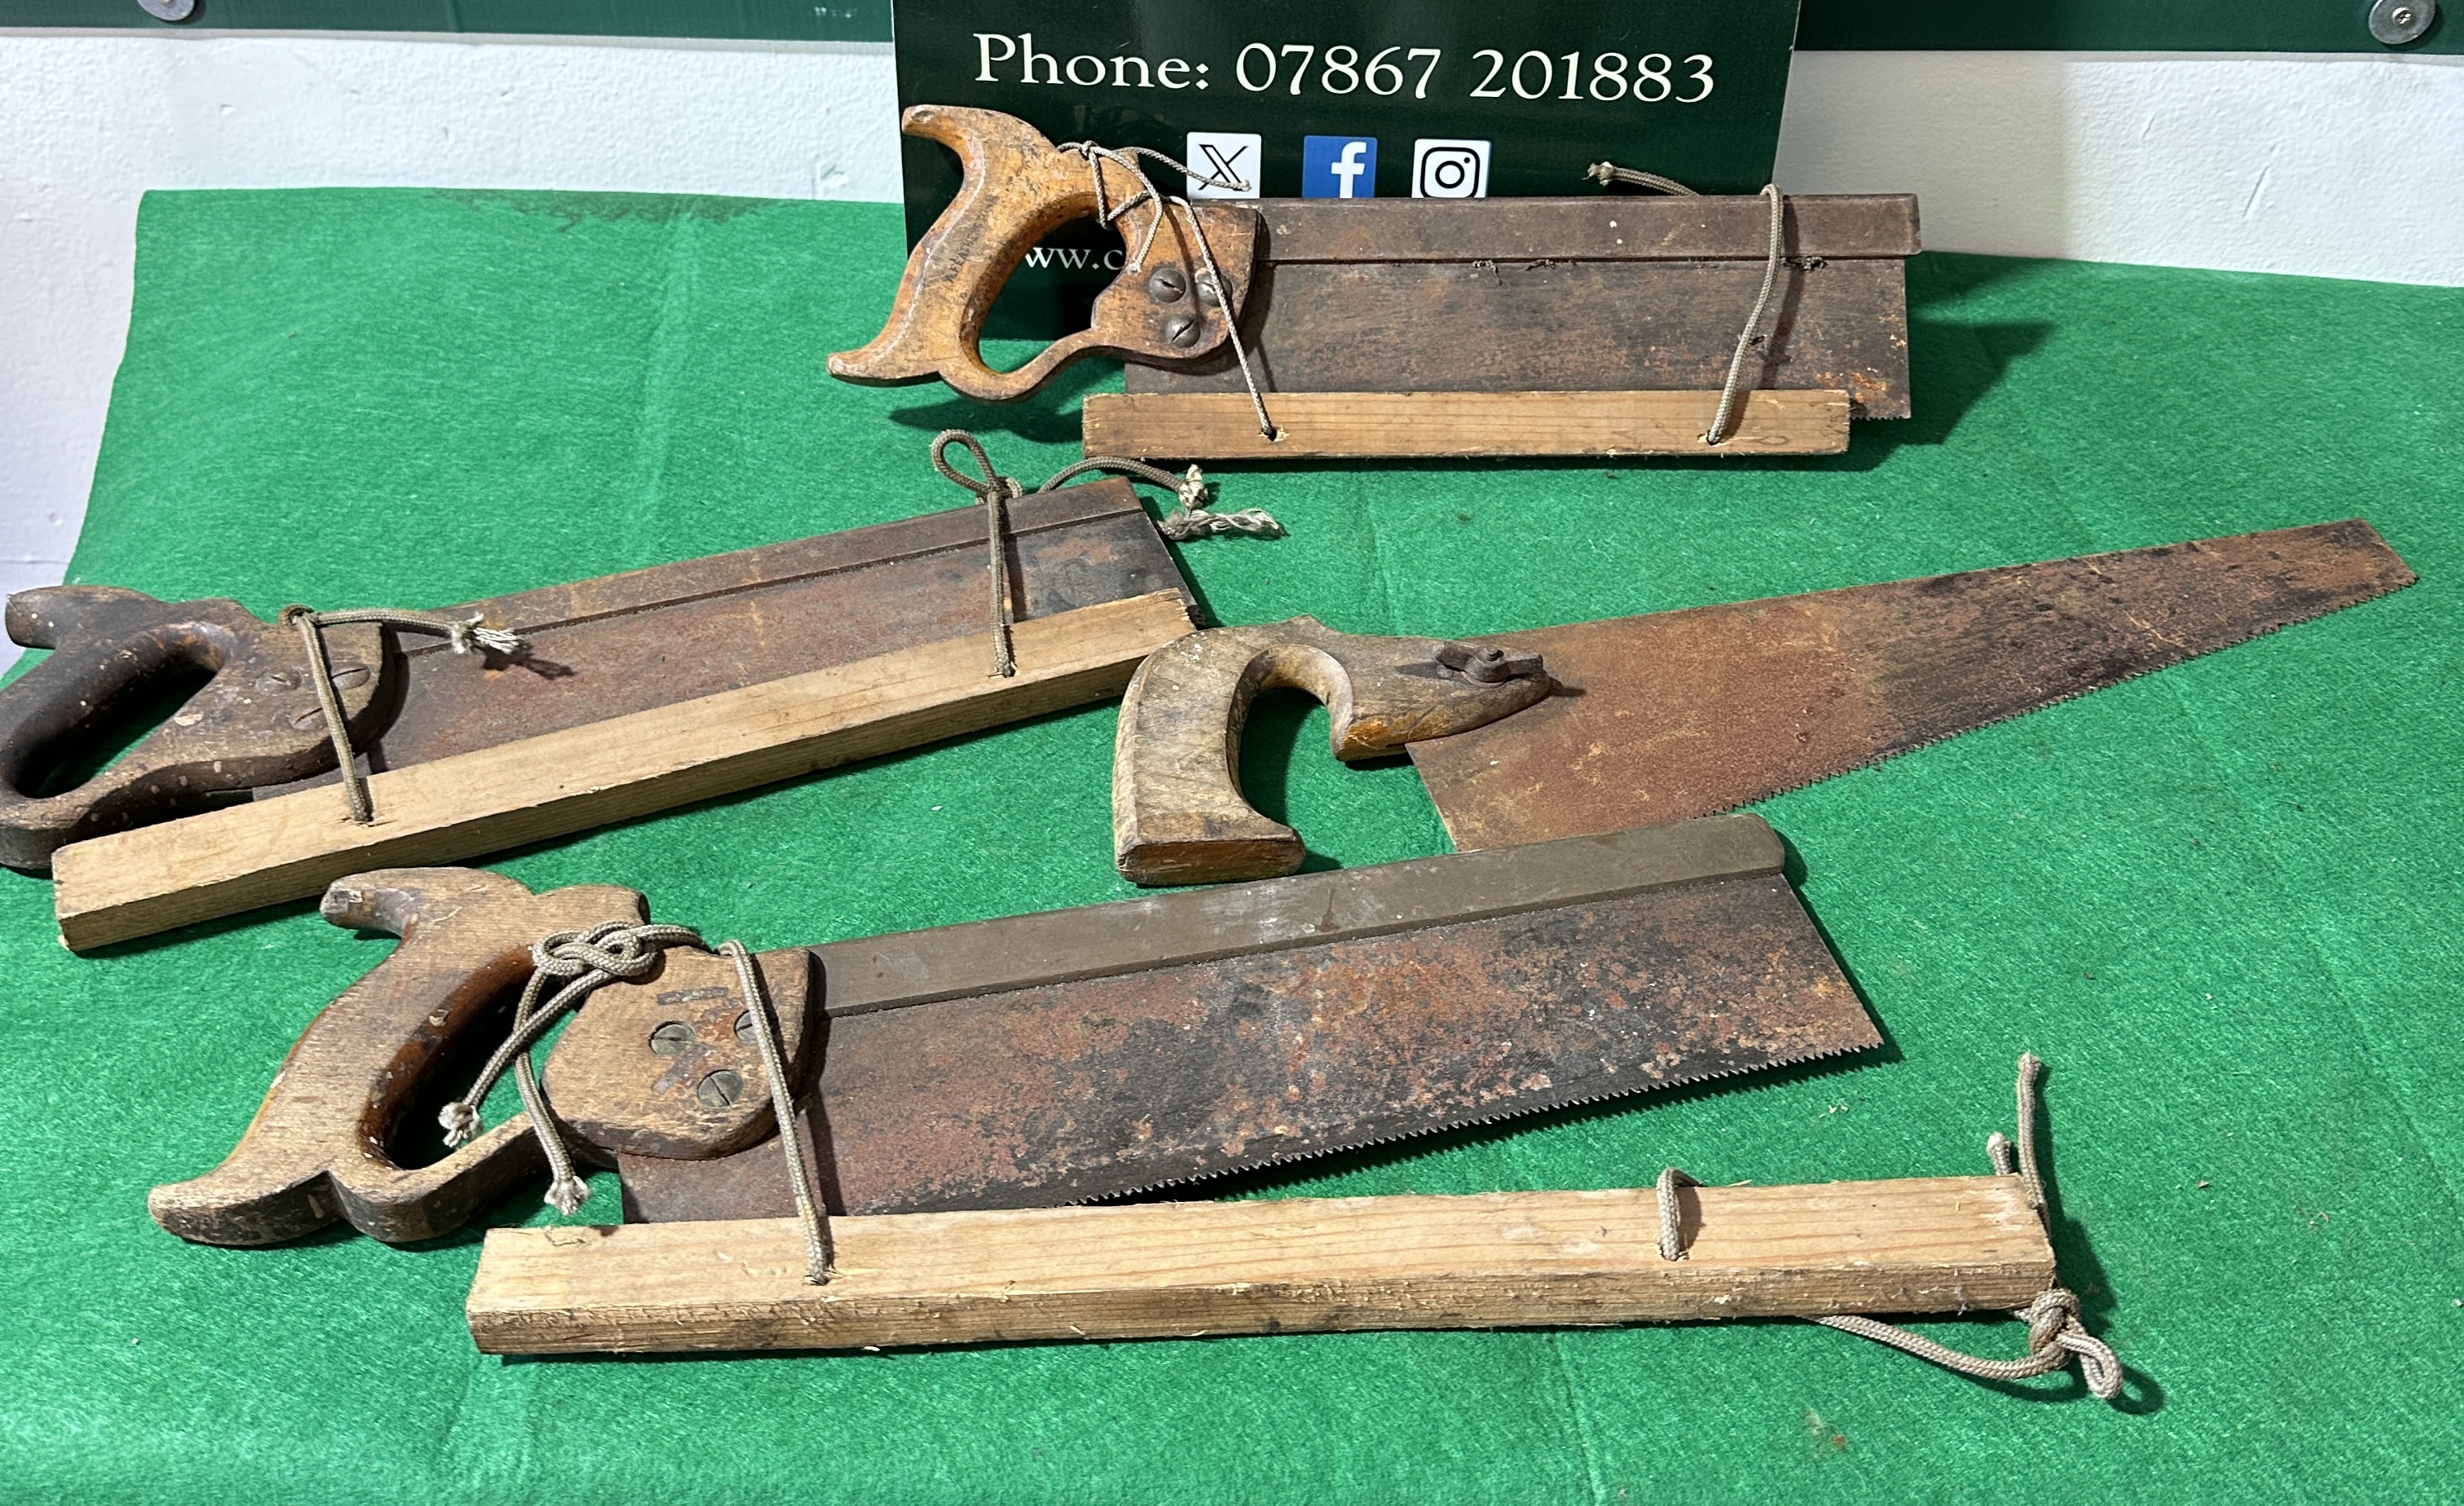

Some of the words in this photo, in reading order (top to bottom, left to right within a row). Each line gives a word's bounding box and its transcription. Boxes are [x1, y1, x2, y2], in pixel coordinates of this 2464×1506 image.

[972, 32, 1209, 90] Phone:
[1235, 42, 1441, 99] 07867
[1469, 49, 1714, 103] 201883
